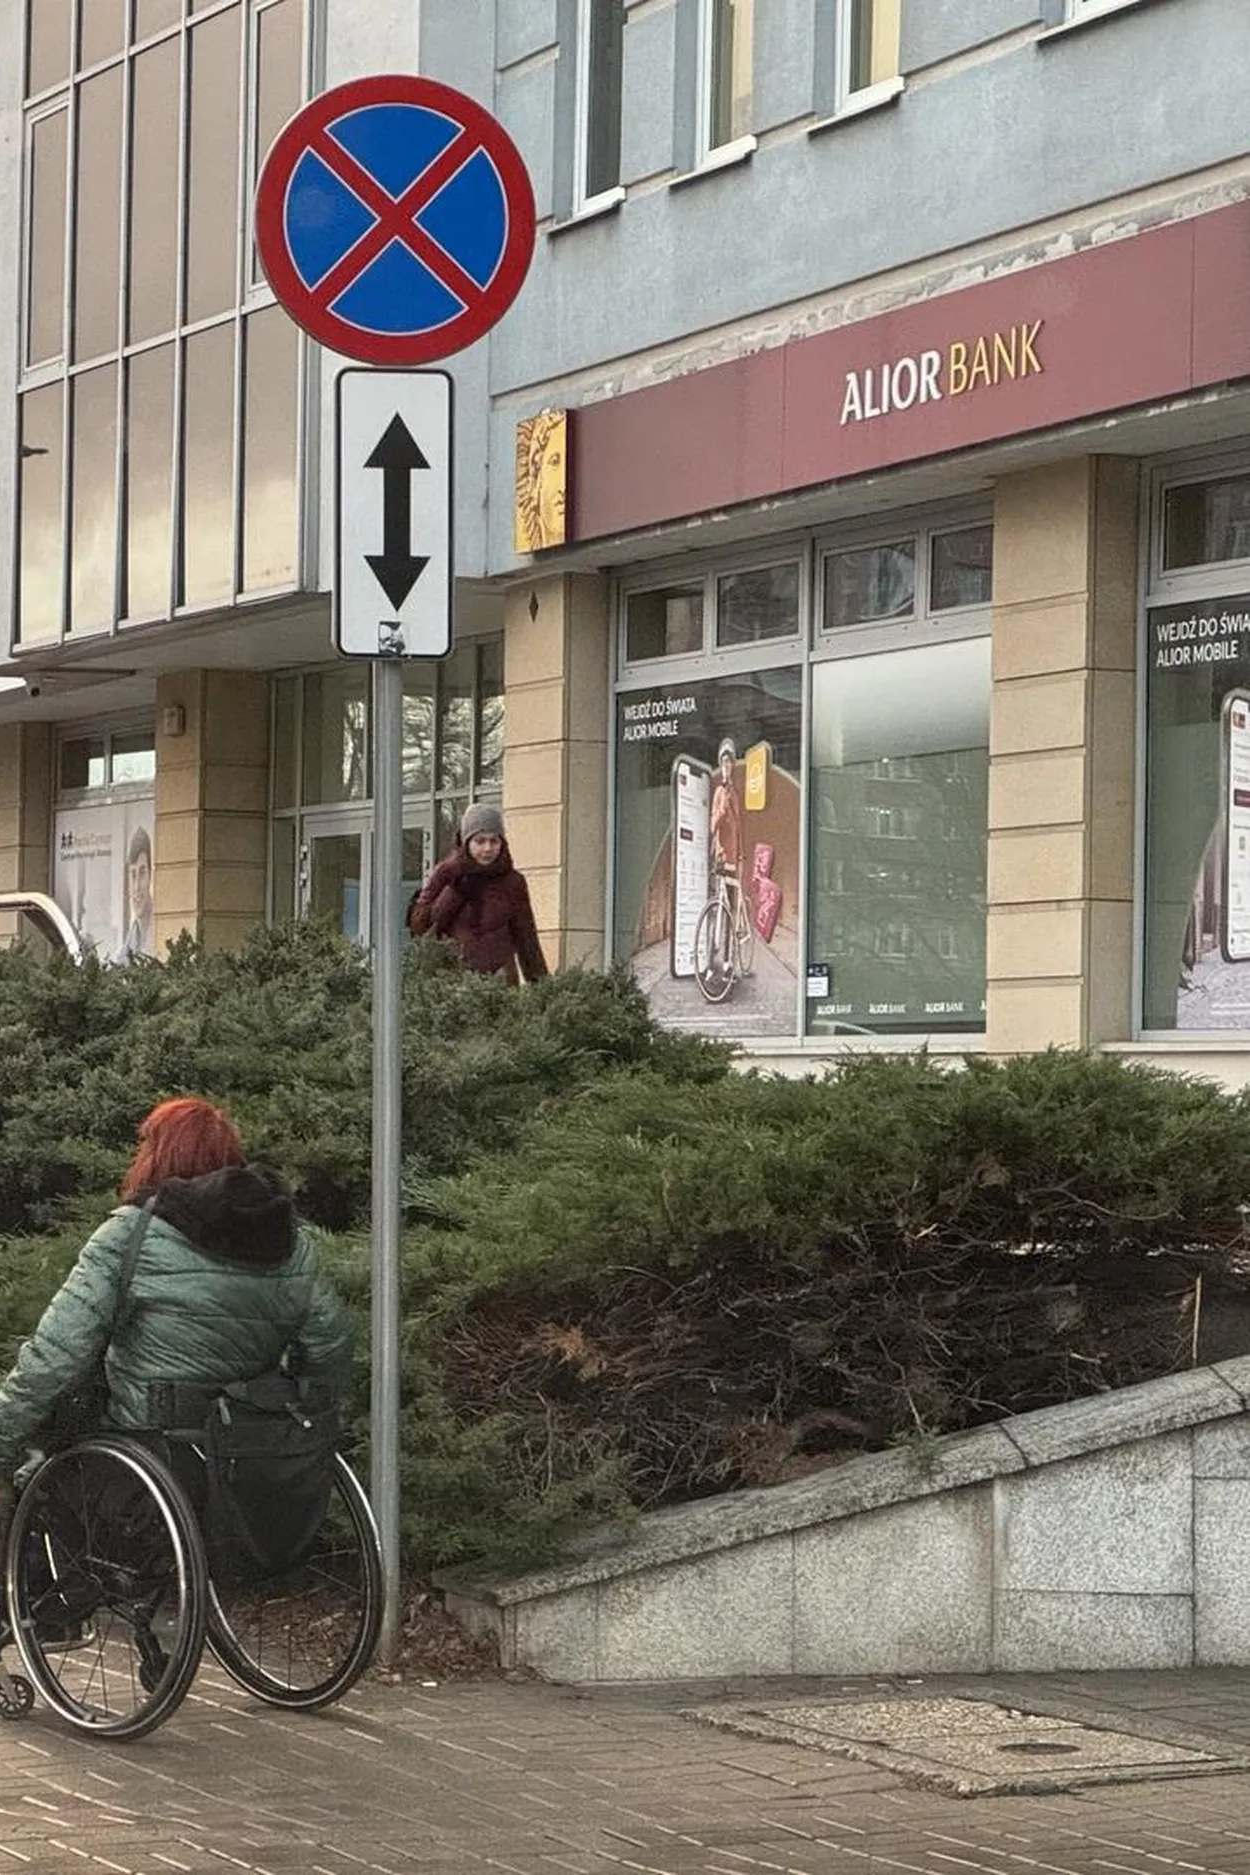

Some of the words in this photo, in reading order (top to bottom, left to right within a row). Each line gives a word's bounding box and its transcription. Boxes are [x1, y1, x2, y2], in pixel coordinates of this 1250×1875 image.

[839, 349, 942, 425] ALIOR
[948, 319, 1046, 396] BANK
[1156, 614, 1197, 642] WEJDŹ
[1199, 617, 1218, 637] DO
[1156, 646, 1191, 667] ALIOR
[1193, 640, 1239, 663] MOBILE
[652, 701, 665, 717] DO
[623, 724, 648, 741] ALIOR
[649, 720, 678, 738] MOBILE
